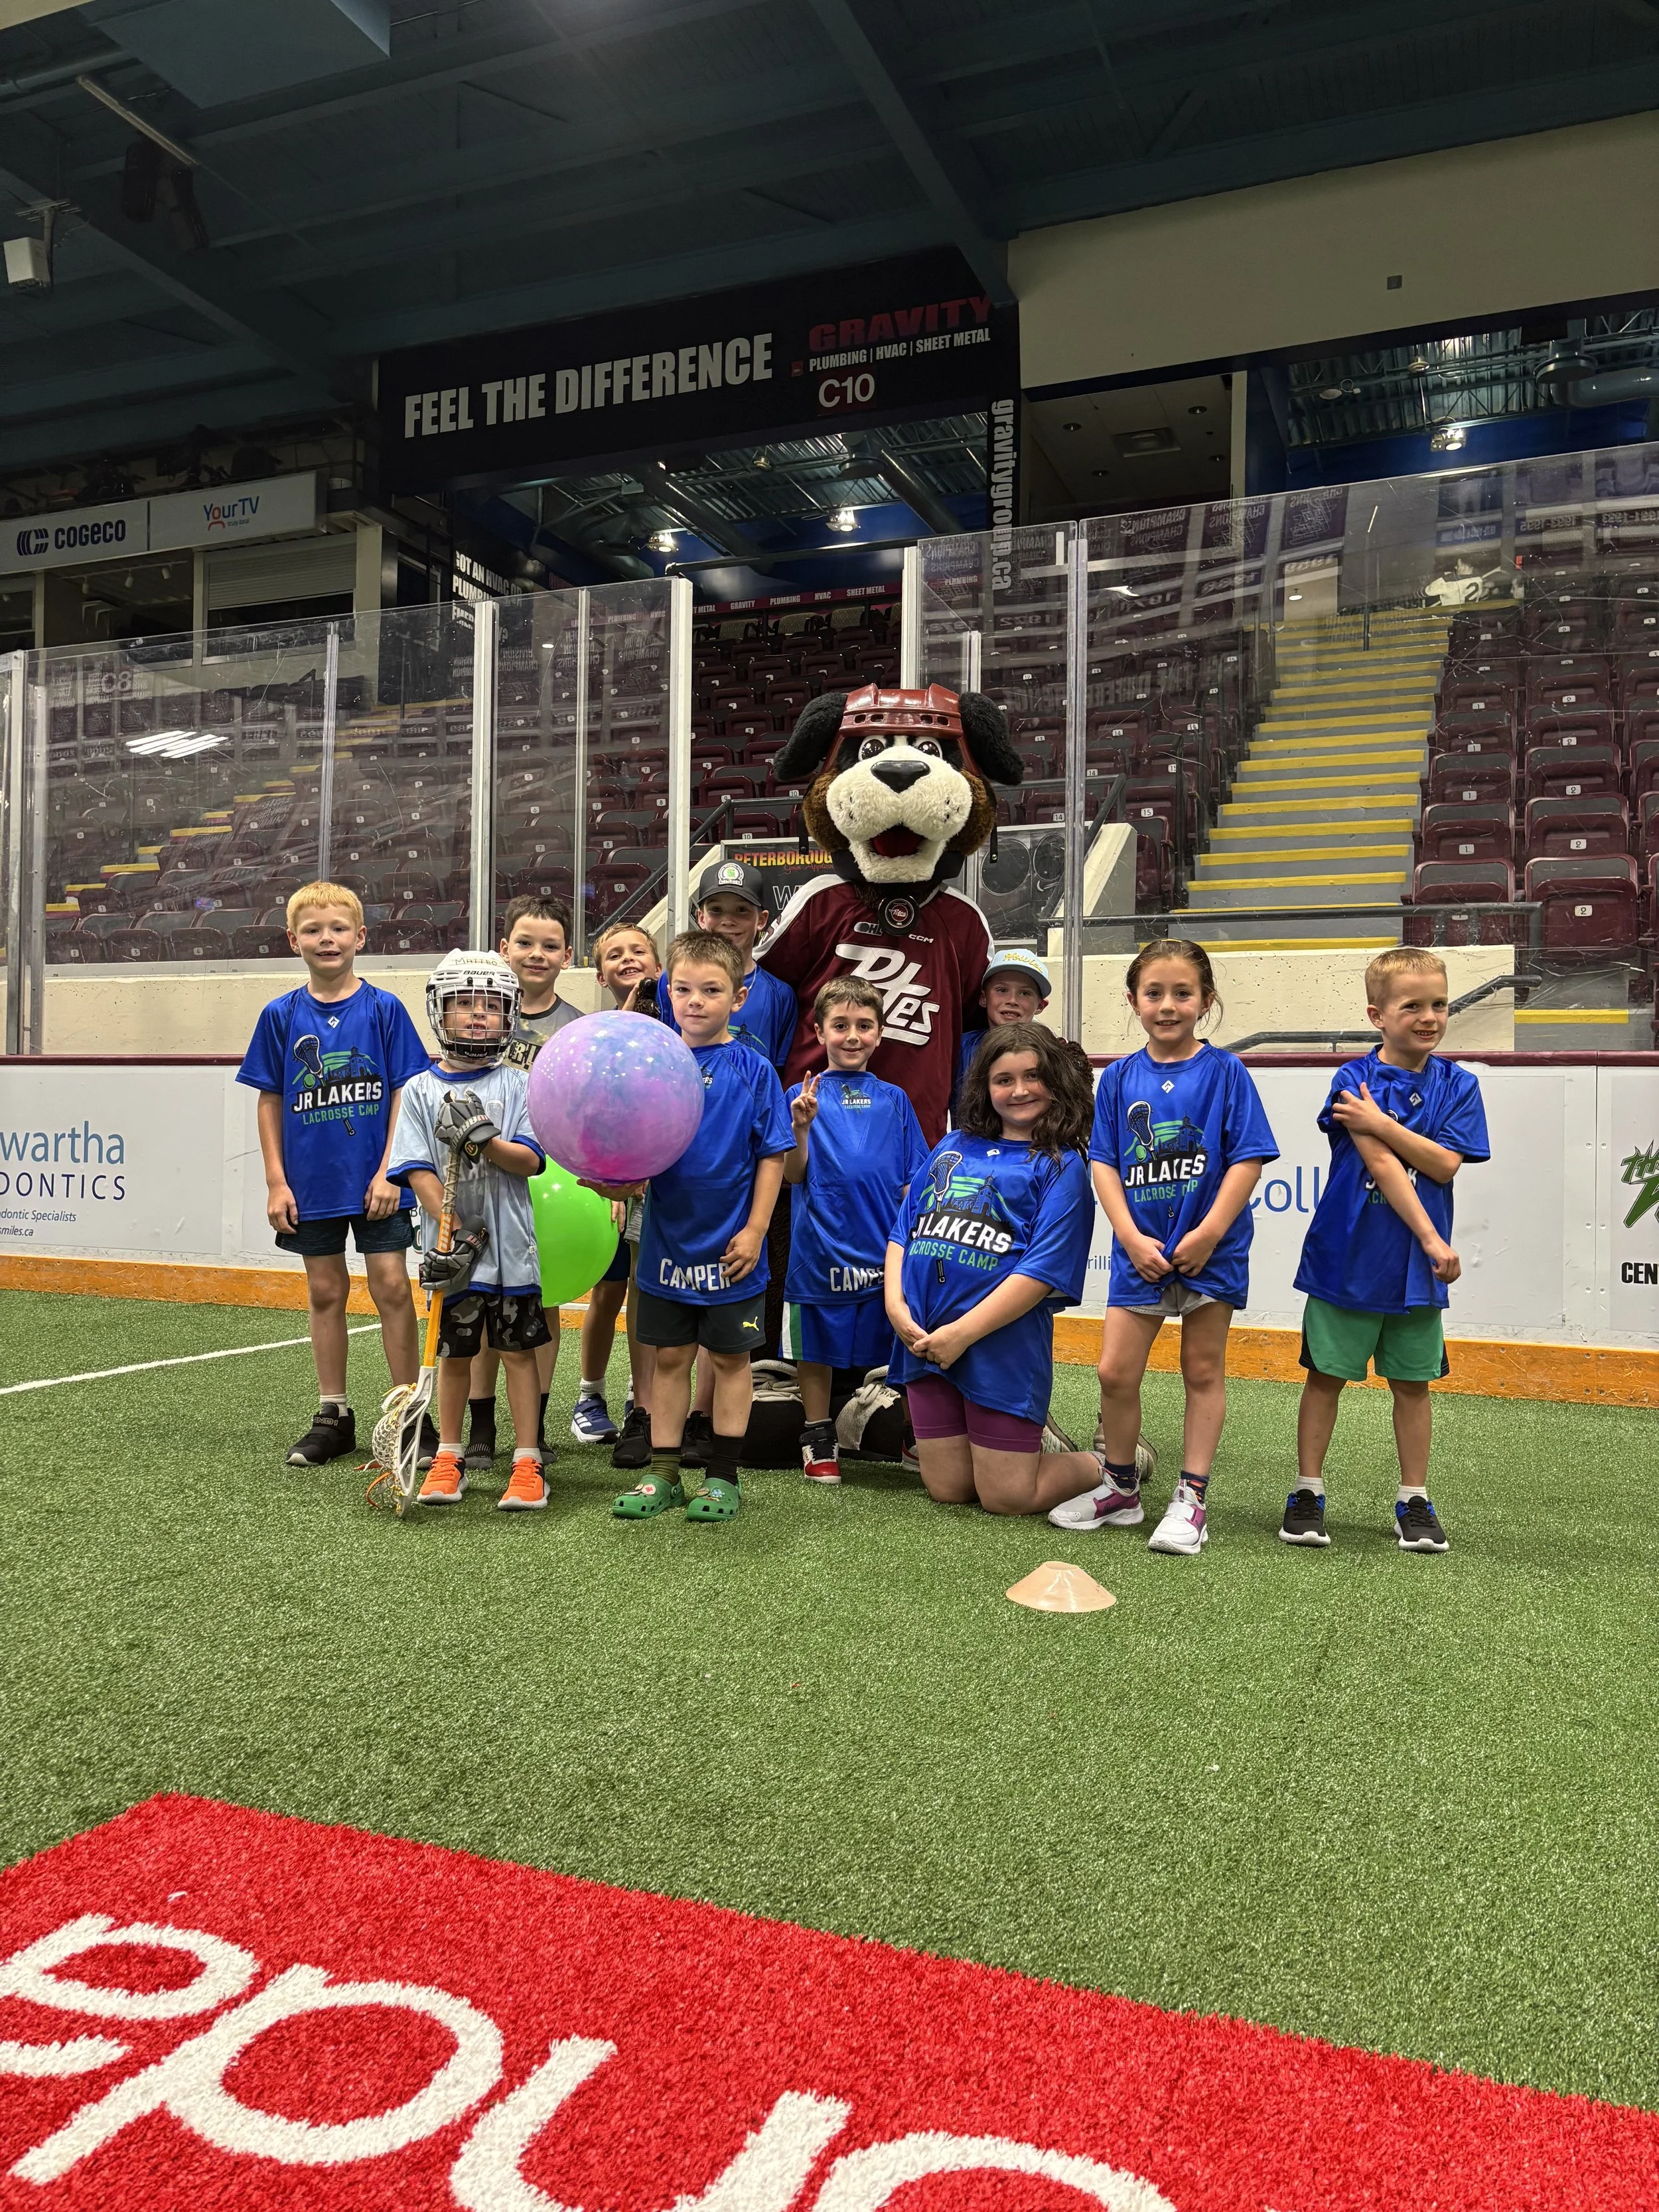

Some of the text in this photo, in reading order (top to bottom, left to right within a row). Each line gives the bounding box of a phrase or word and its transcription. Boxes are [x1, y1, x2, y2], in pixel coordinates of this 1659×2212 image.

[809, 295, 993, 352] GRAVITY
[809, 328, 990, 372] PLUMBING HVAC SHEET METAL
[404, 332, 772, 438] FEEL THE DIFFERENCE
[818, 373, 875, 407] C10
[991, 399, 1018, 590] gravitygroup.ca
[472, 561, 485, 584] AN
[486, 569, 510, 596] HVAC
[770, 595, 800, 605] PLUMBING
[814, 591, 831, 601] HVAC
[846, 585, 886, 597] SHEET METAL
[697, 605, 716, 614] METAL
[730, 600, 755, 610] GRAVITY
[734, 849, 833, 867] PETERBOROUG
[908, 934, 934, 943] CCM
[455, 958, 498, 966] MATTEO
[835, 943, 940, 1045] Ptes
[294, 1081, 382, 1112] JR LAKERS
[302, 1106, 354, 1125] LACROSSE
[1125, 1165, 1144, 1187] JR
[31, 1210, 77, 1222] Specialists
[923, 1213, 1012, 1253] LAKERS
[958, 1248, 998, 1272] CAMP
[1621, 1262, 1659, 1285] CEN
